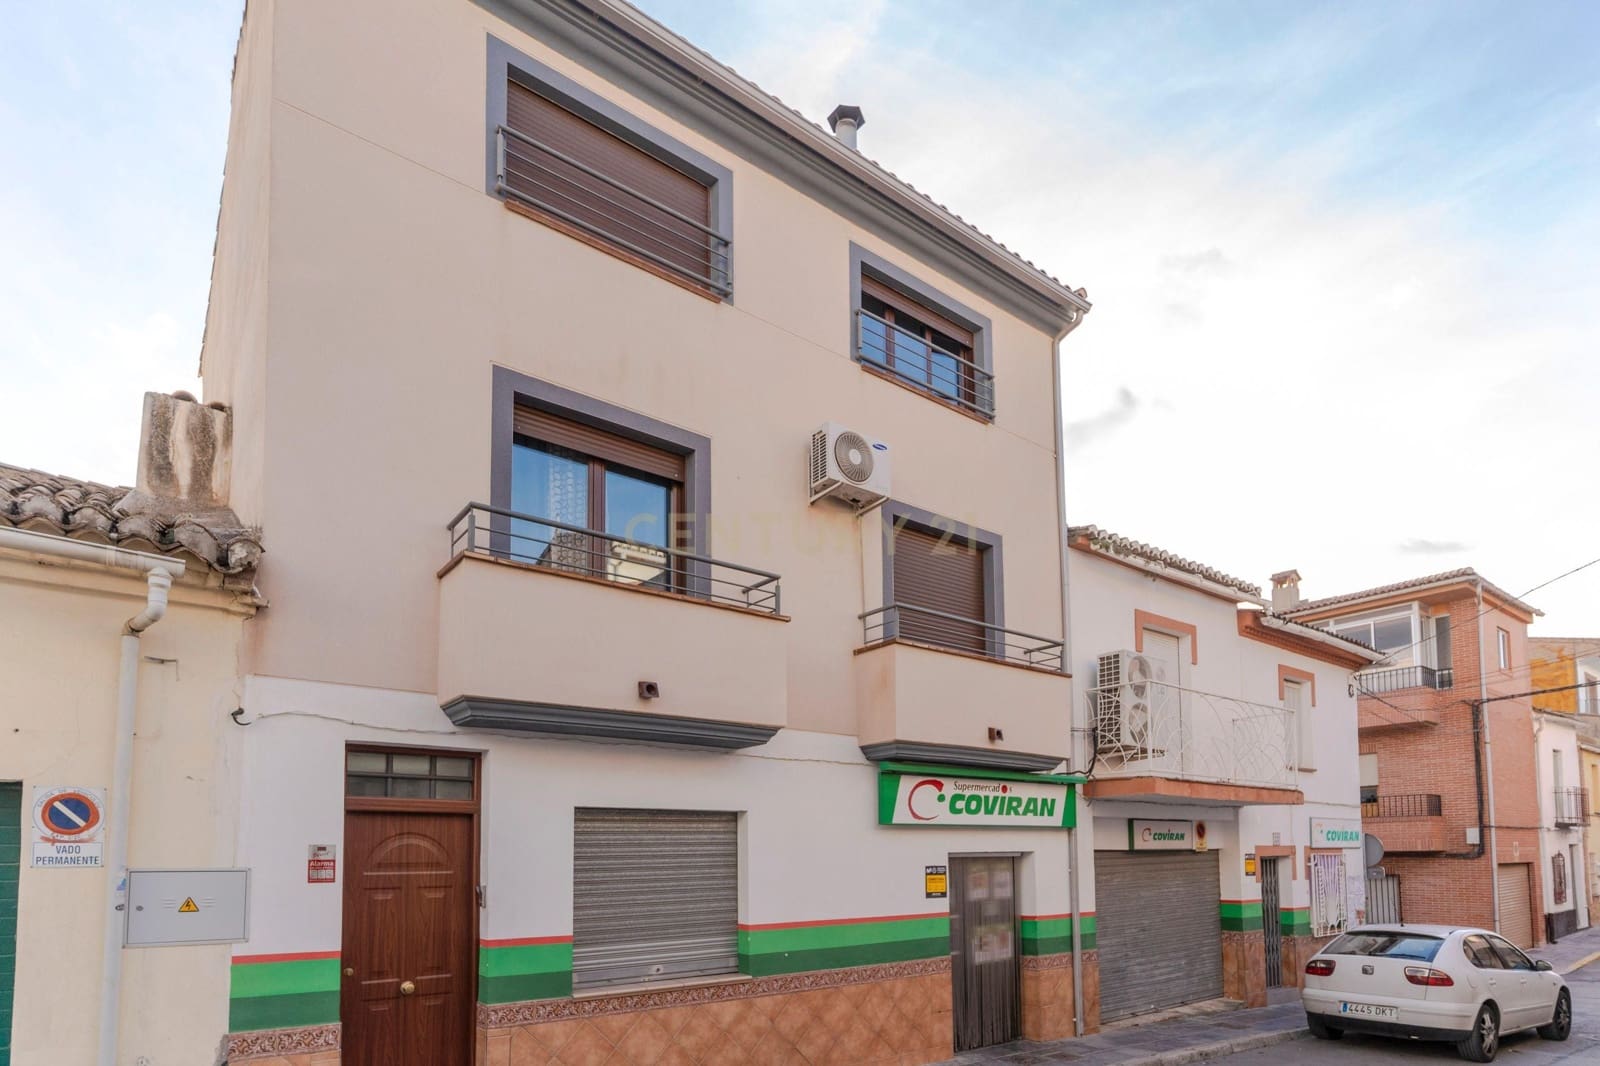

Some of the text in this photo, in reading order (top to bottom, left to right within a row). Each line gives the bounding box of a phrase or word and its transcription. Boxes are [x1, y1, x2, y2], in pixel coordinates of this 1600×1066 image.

[948, 793, 1057, 817] COVIRAN
[1152, 831, 1185, 841] COVIRAN
[1325, 829, 1360, 842] COVIRAN
[55, 845, 81, 854] VADO
[35, 856, 100, 865] PERMANENTE
[1348, 1004, 1394, 1017] 4445 DKT
